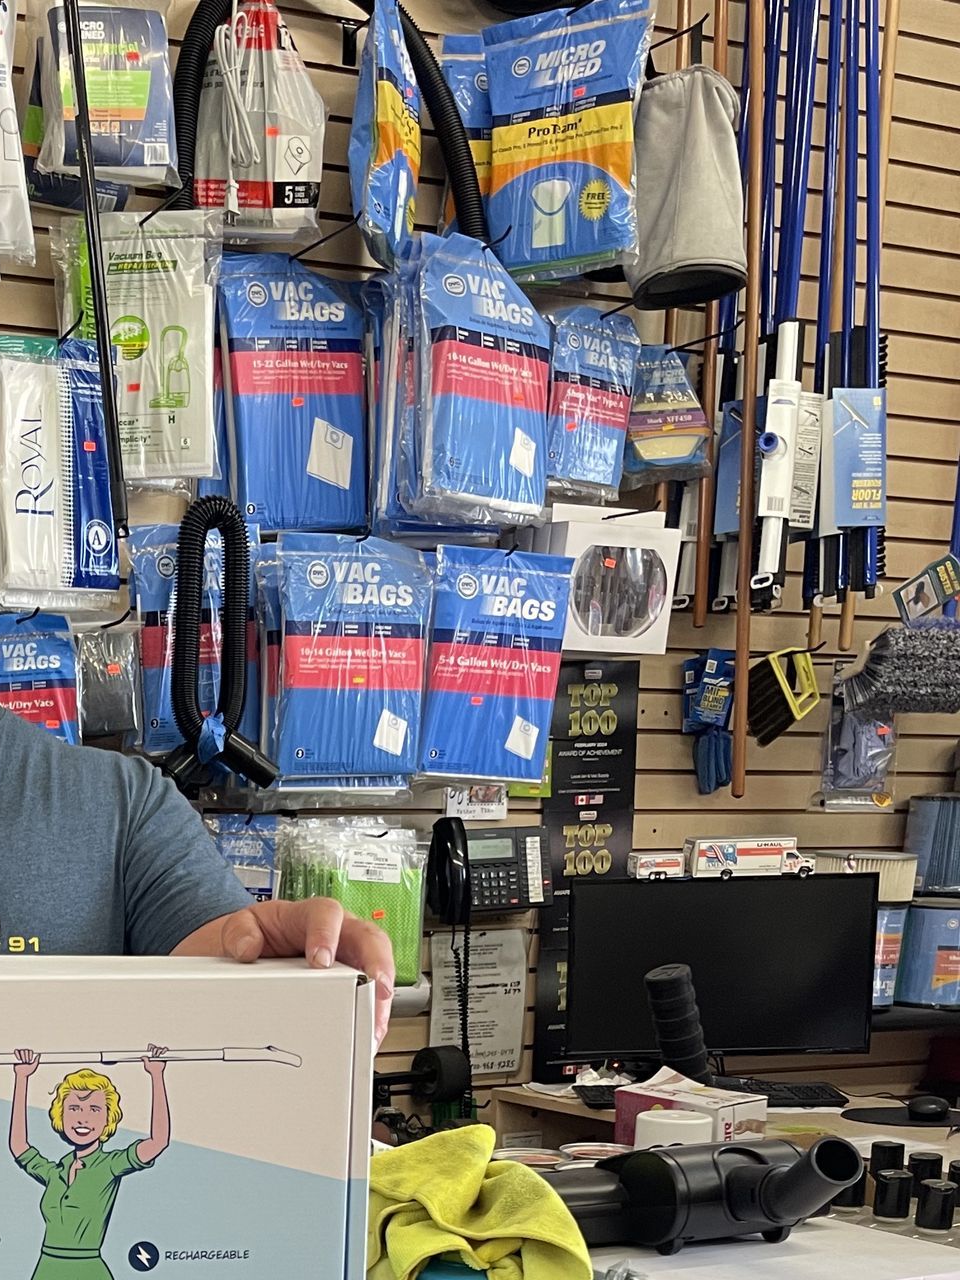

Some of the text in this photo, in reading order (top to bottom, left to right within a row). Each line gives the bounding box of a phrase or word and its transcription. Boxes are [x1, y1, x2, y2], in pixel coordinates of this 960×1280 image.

[534, 40, 606, 70] MICRO
[542, 61, 602, 87] LINED
[284, 185, 293, 204] 5
[108, 252, 143, 261] Vacuum
[269, 281, 314, 302] VAC
[468, 274, 506, 300] VAC
[284, 301, 346, 322] BAGS
[481, 299, 534, 325] BAGS
[583, 335, 611, 353] VAC
[274, 360, 298, 369] Gallon
[300, 360, 331, 372] Wet/Dry
[332, 360, 348, 369] Vacs
[468, 356, 491, 370] Gallon
[490, 361, 518, 375] Wet/Dry
[602, 394, 617, 408] Type
[618, 401, 624, 409] A
[168, 414, 176, 424] H
[183, 438, 188, 446] 6
[15, 418, 55, 518] ROYAL
[852, 488, 882, 501] FLOOR
[248, 504, 254, 514] 3
[91, 529, 102, 546] A
[332, 562, 382, 583] VAC
[345, 583, 414, 606] BAGS
[480, 574, 528, 597] VAC
[492, 595, 556, 622] BAGS
[1, 642, 37, 657] VAC
[325, 647, 353, 658] Gallon
[389, 649, 407, 659] Vacs
[11, 654, 61, 670] BAGS
[457, 655, 488, 668] Gallon
[490, 658, 529, 672] Wet/Dry
[530, 663, 551, 673] Vacs
[37, 699, 54, 709] Vacs
[568, 683, 618, 708] TOP
[568, 709, 617, 737] 100
[297, 749, 304, 758] 3
[558, 749, 577, 757] AWARD
[562, 823, 613, 848] TOP
[563, 849, 612, 877] 100
[8, 936, 40, 952] 91
[164, 1250, 250, 1261] RECHARGEABLE
